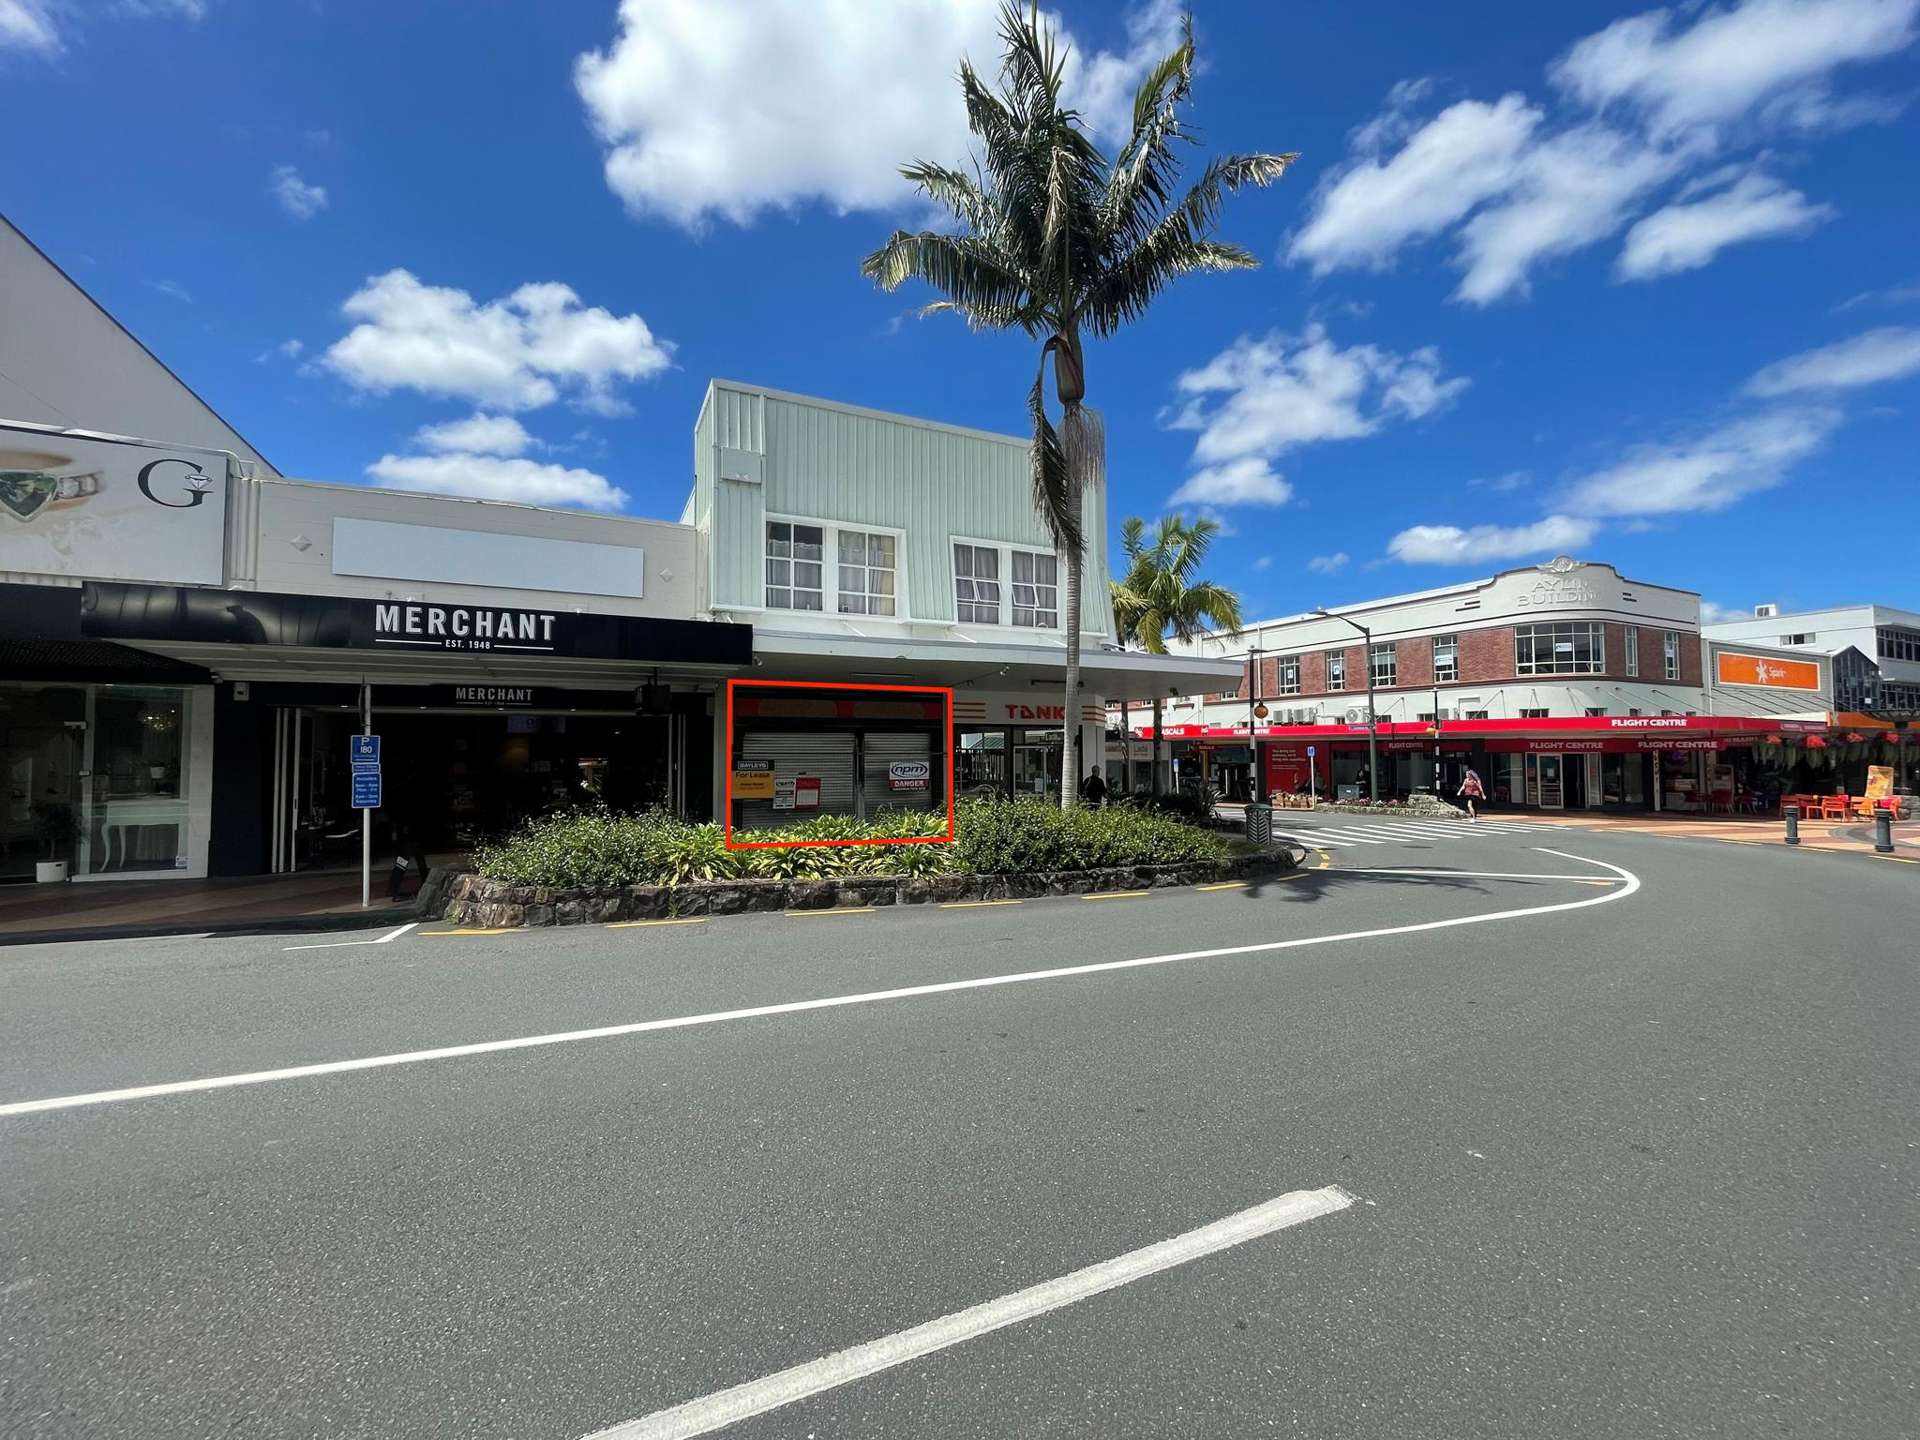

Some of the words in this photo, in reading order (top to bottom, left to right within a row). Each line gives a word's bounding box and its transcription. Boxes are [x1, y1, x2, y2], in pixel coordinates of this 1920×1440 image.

[137, 458, 214, 508] G
[375, 604, 556, 641] MERCHANT
[445, 639, 465, 648] EST.
[469, 640, 491, 649] 1948
[456, 687, 533, 701] MERCHANT
[1611, 719, 1648, 727] FLIGHT
[1650, 719, 1688, 727] CENTRE
[1161, 727, 1185, 736] ASCALS
[361, 737, 370, 746] P
[1529, 741, 1563, 749] FLIGHT
[1565, 741, 1604, 749] CENTRE
[1638, 740, 1674, 749] FLIGHT
[1675, 741, 1718, 749] CENTRE
[360, 745, 373, 754] 180
[895, 766, 923, 775] npm
